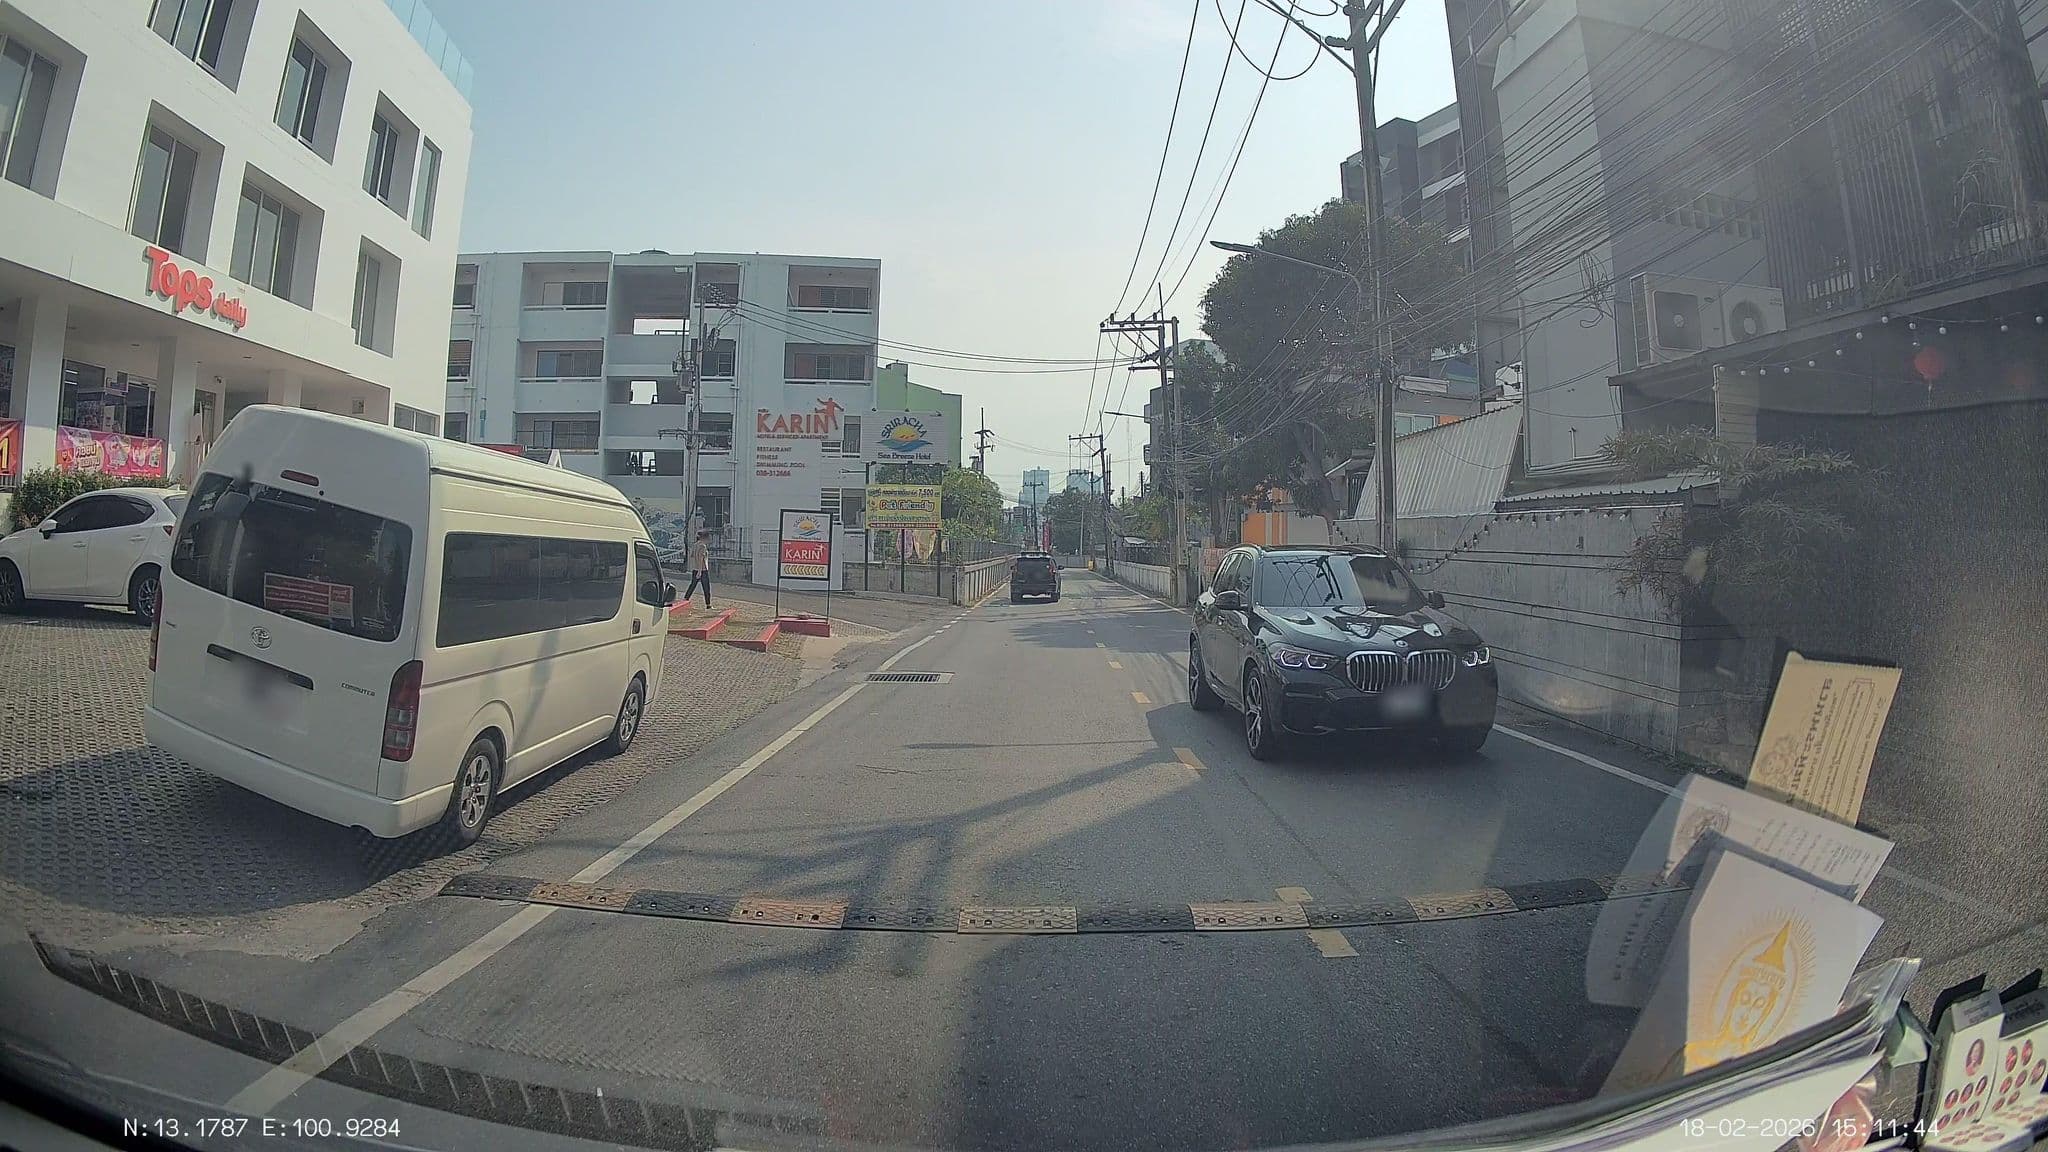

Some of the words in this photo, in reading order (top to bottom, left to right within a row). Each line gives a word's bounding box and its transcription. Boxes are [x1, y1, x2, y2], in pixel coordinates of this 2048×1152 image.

[142, 245, 214, 315] Tops
[211, 291, 247, 332] daily
[757, 413, 829, 434] KARIN
[881, 416, 927, 439] SRIRACHA
[785, 549, 821, 560] KARIN
